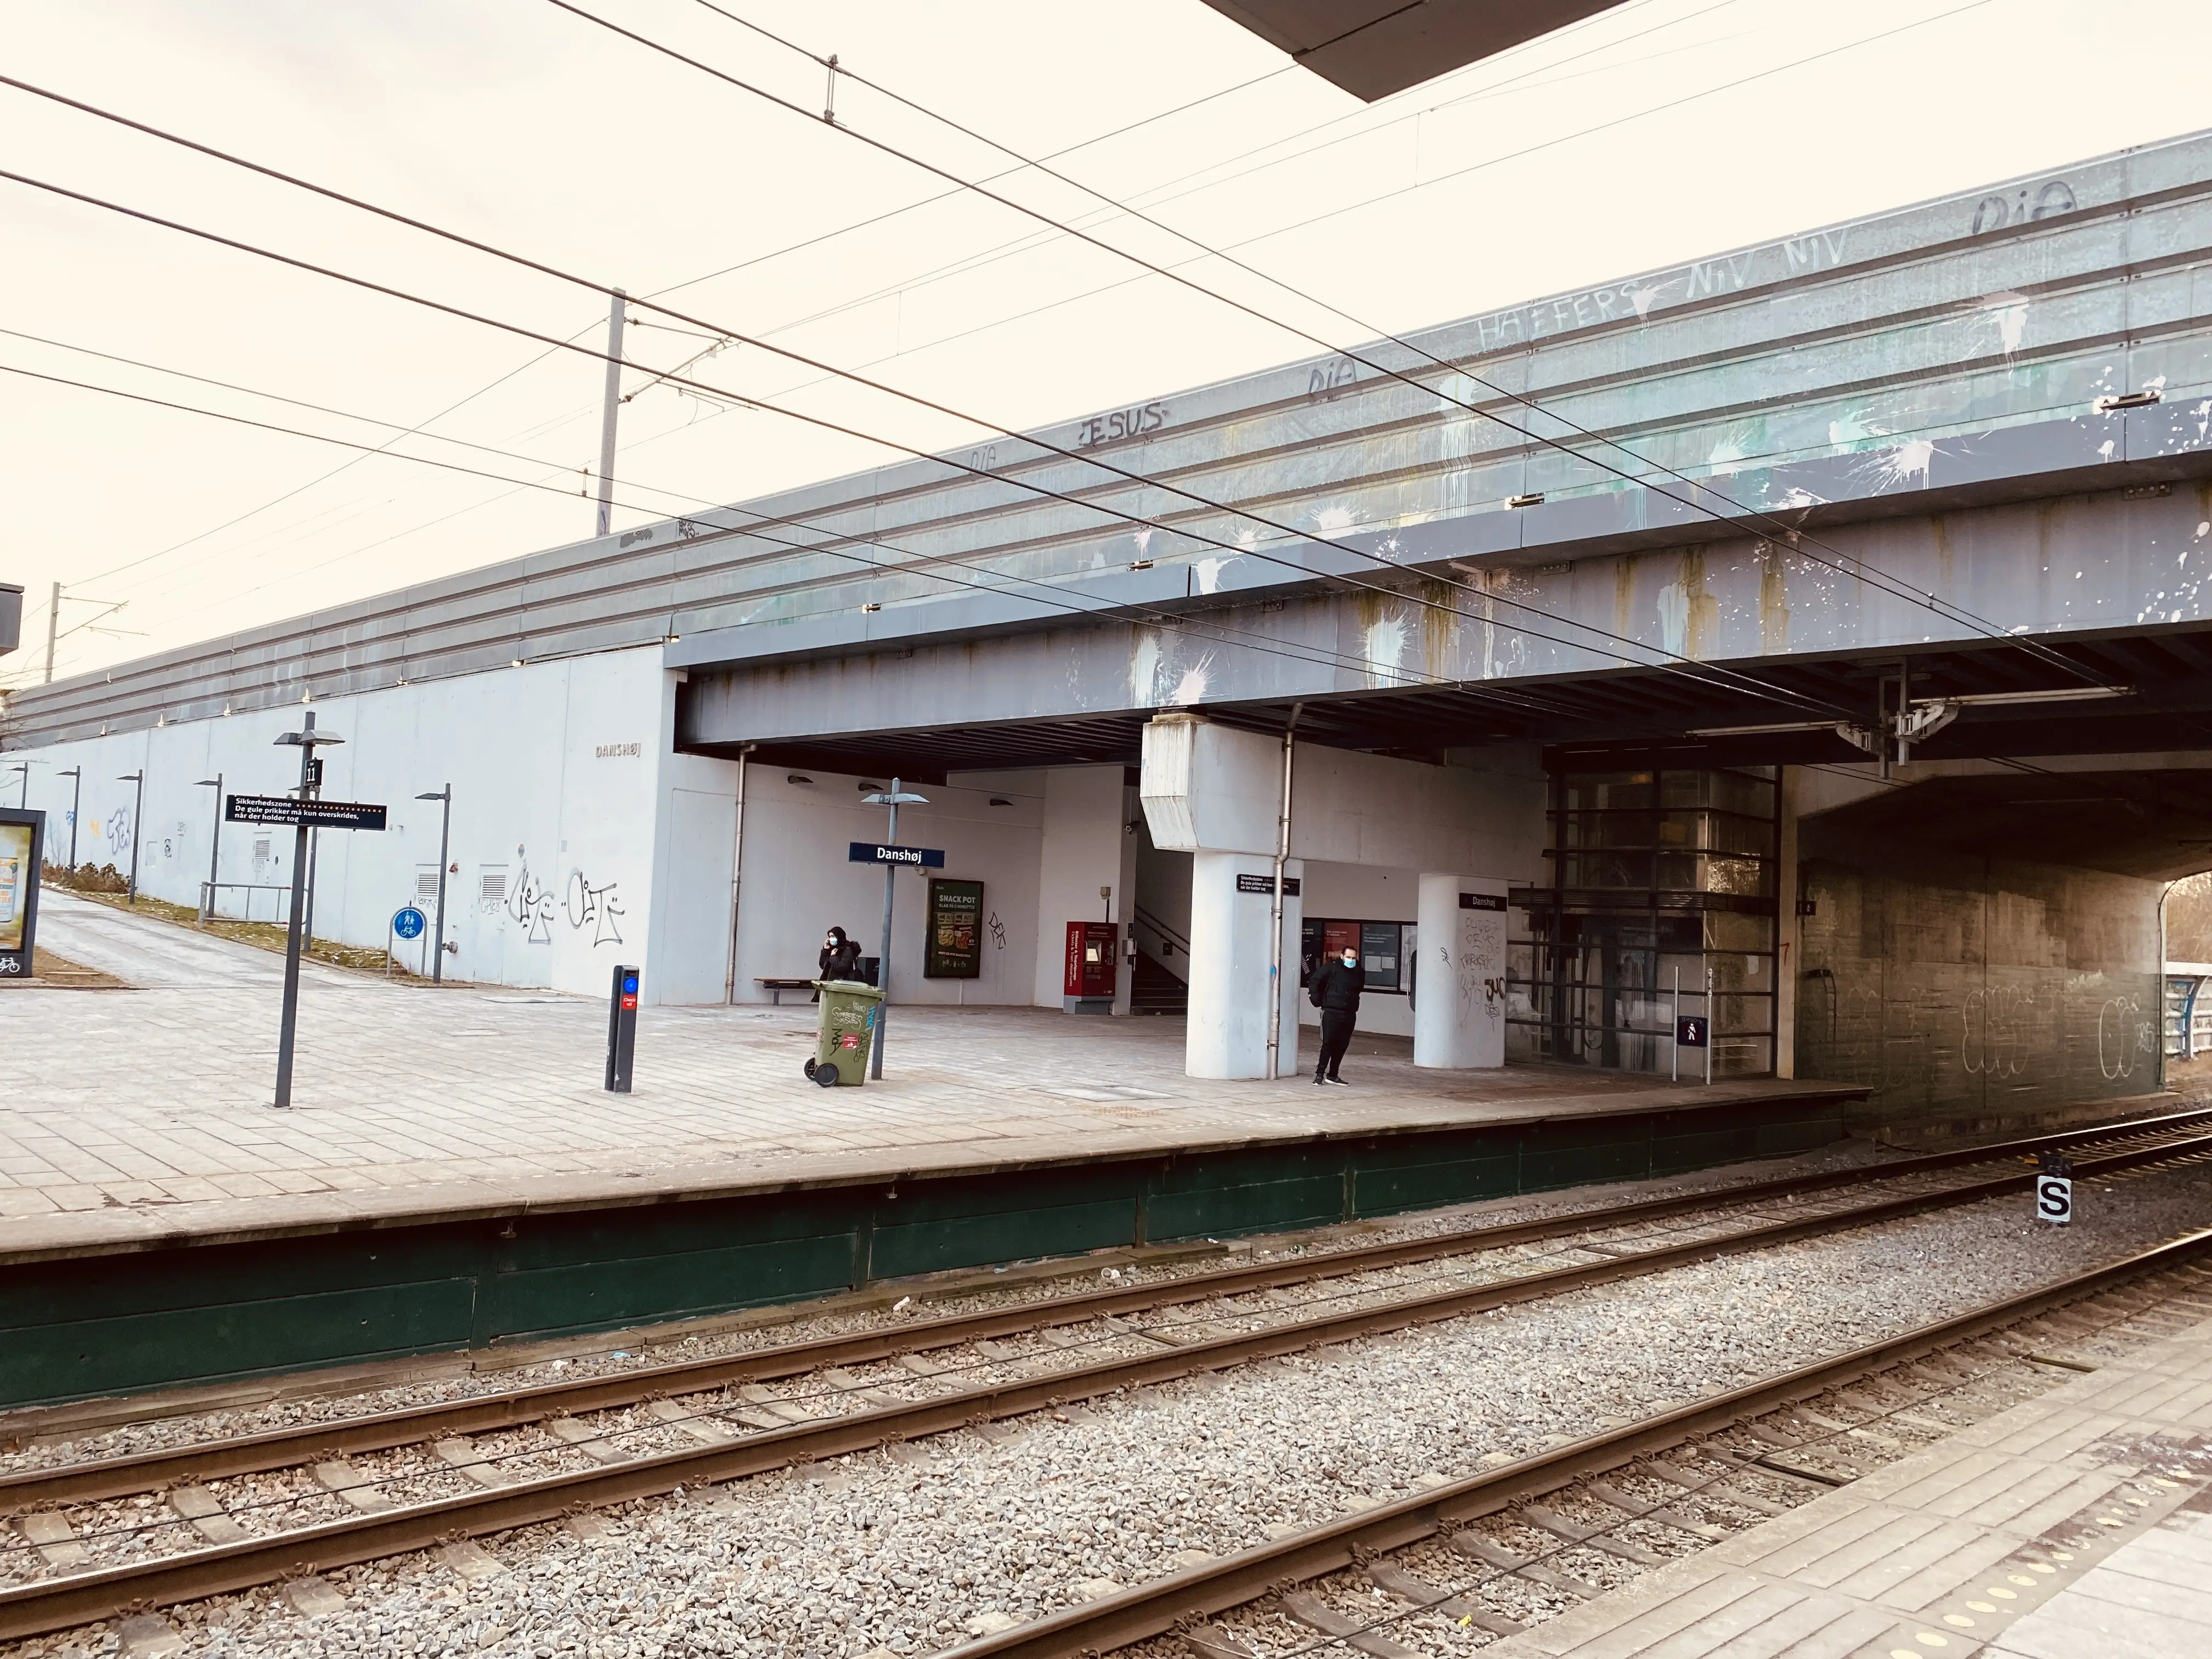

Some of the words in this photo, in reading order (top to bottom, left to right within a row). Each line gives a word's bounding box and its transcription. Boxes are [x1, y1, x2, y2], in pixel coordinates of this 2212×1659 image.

[596, 743, 641, 757] DANSHØJ
[307, 767, 315, 781] 11
[235, 798, 292, 808] Sikkerhedszone
[262, 814, 286, 822] holder
[264, 808, 290, 816] prikker
[318, 811, 359, 820] overskrides,
[877, 847, 922, 864] Danshøj
[939, 895, 962, 903] SNACK
[2040, 1182, 2069, 1216] S
